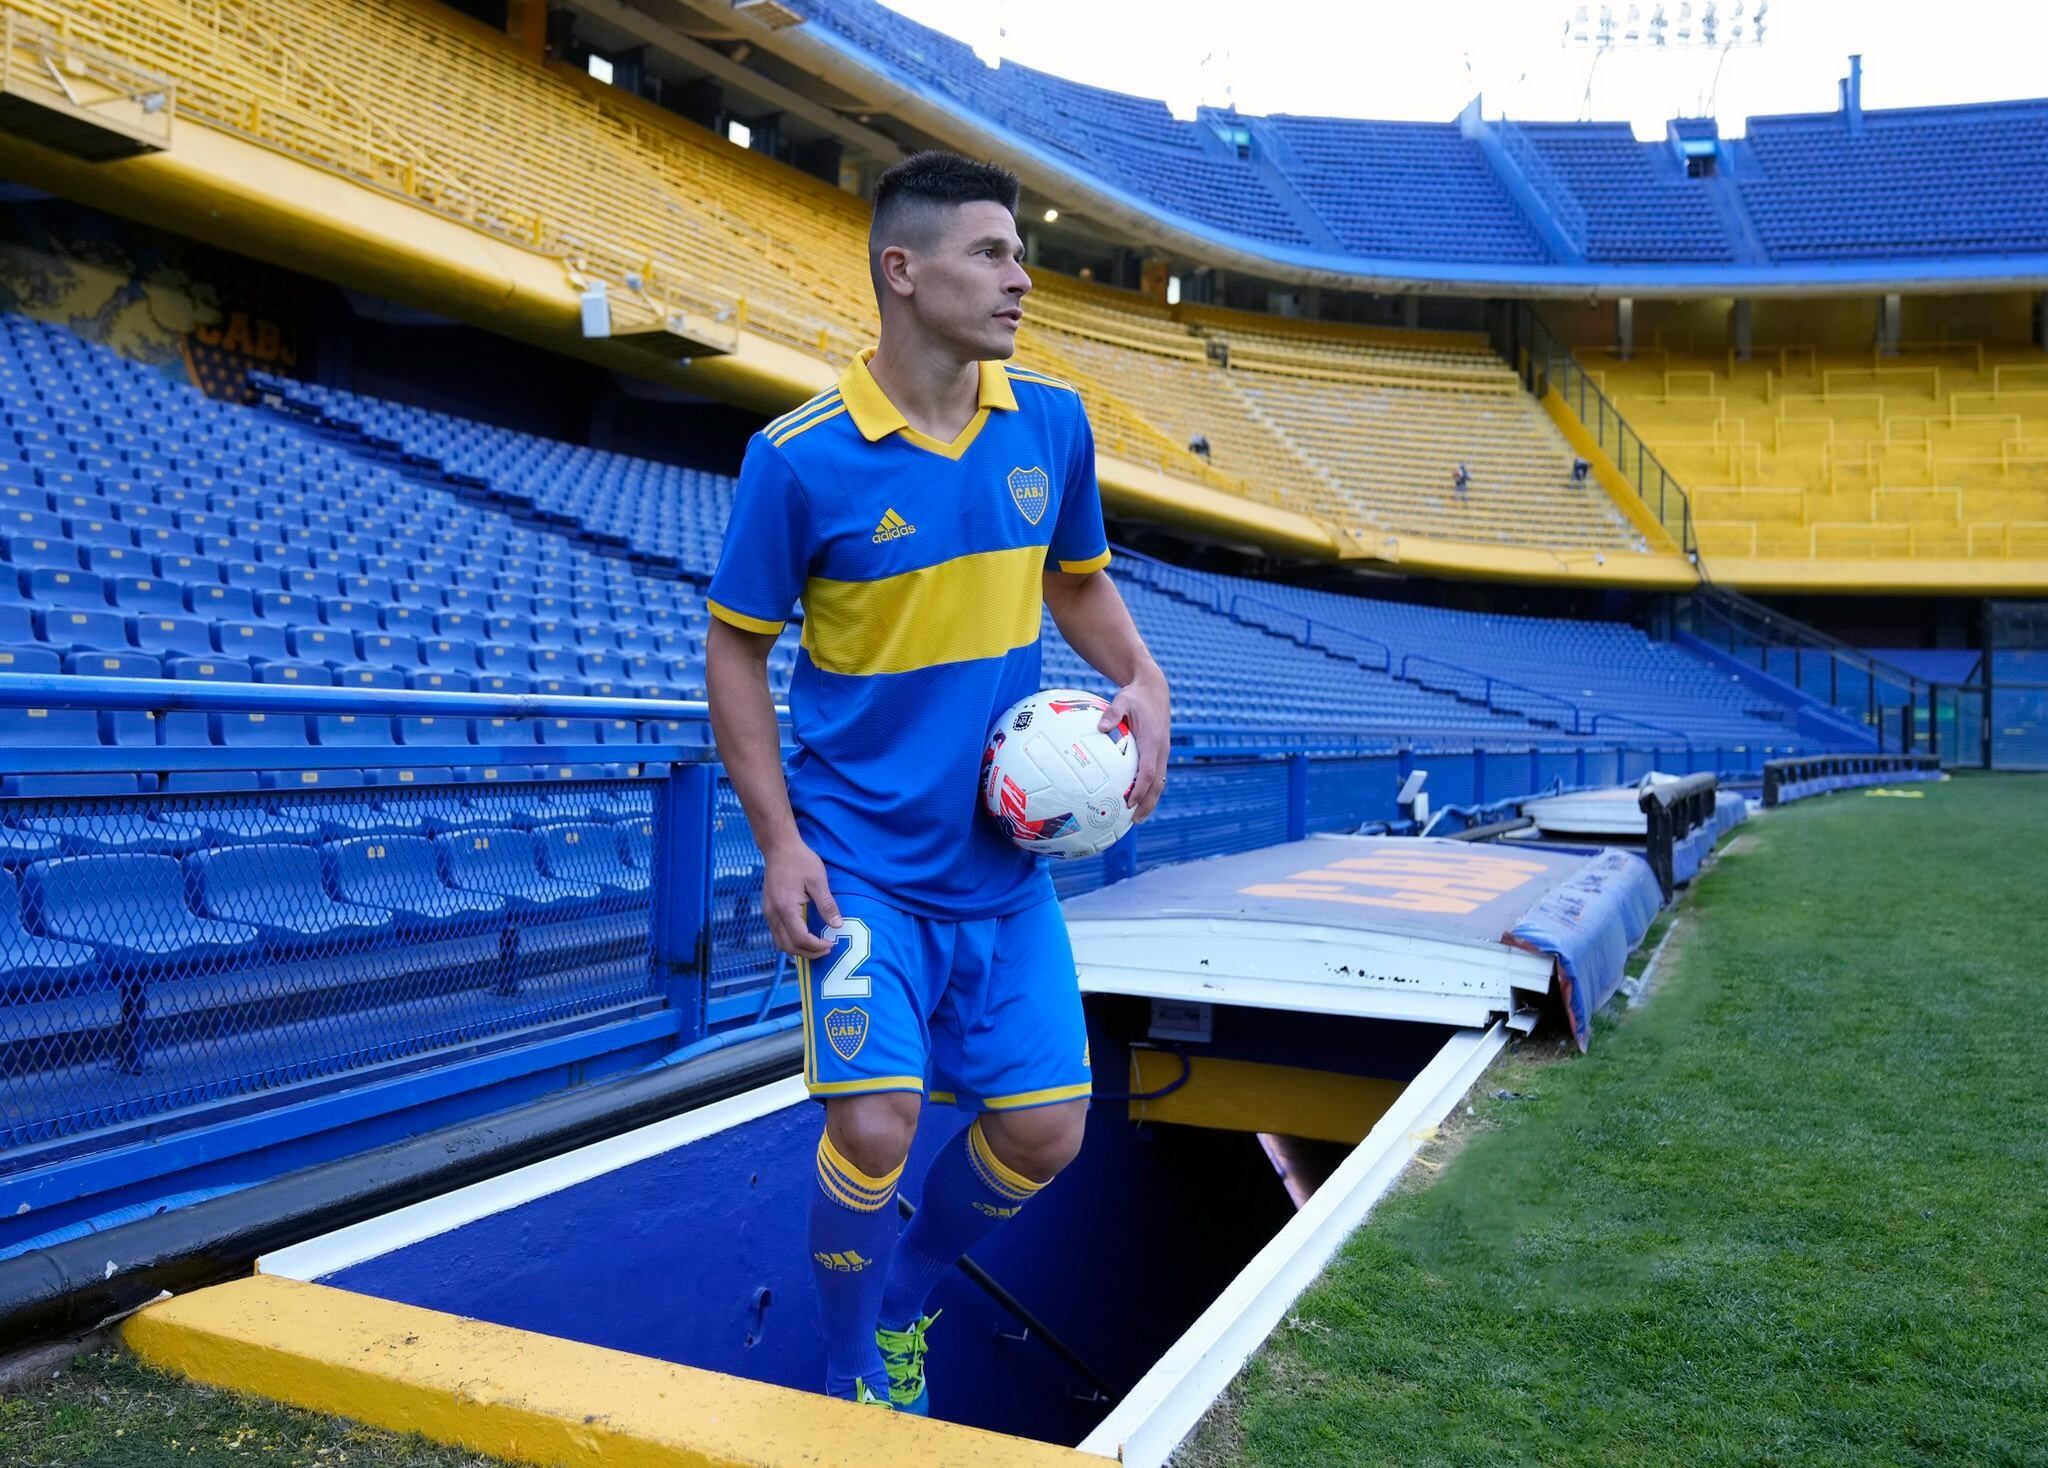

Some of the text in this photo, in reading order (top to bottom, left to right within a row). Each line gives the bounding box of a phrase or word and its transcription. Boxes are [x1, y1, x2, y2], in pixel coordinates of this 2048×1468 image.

[1016, 486, 1043, 499] CABJ
[872, 525, 916, 543] adidas
[821, 917, 871, 999] 2
[831, 1025, 862, 1037] CABJ
